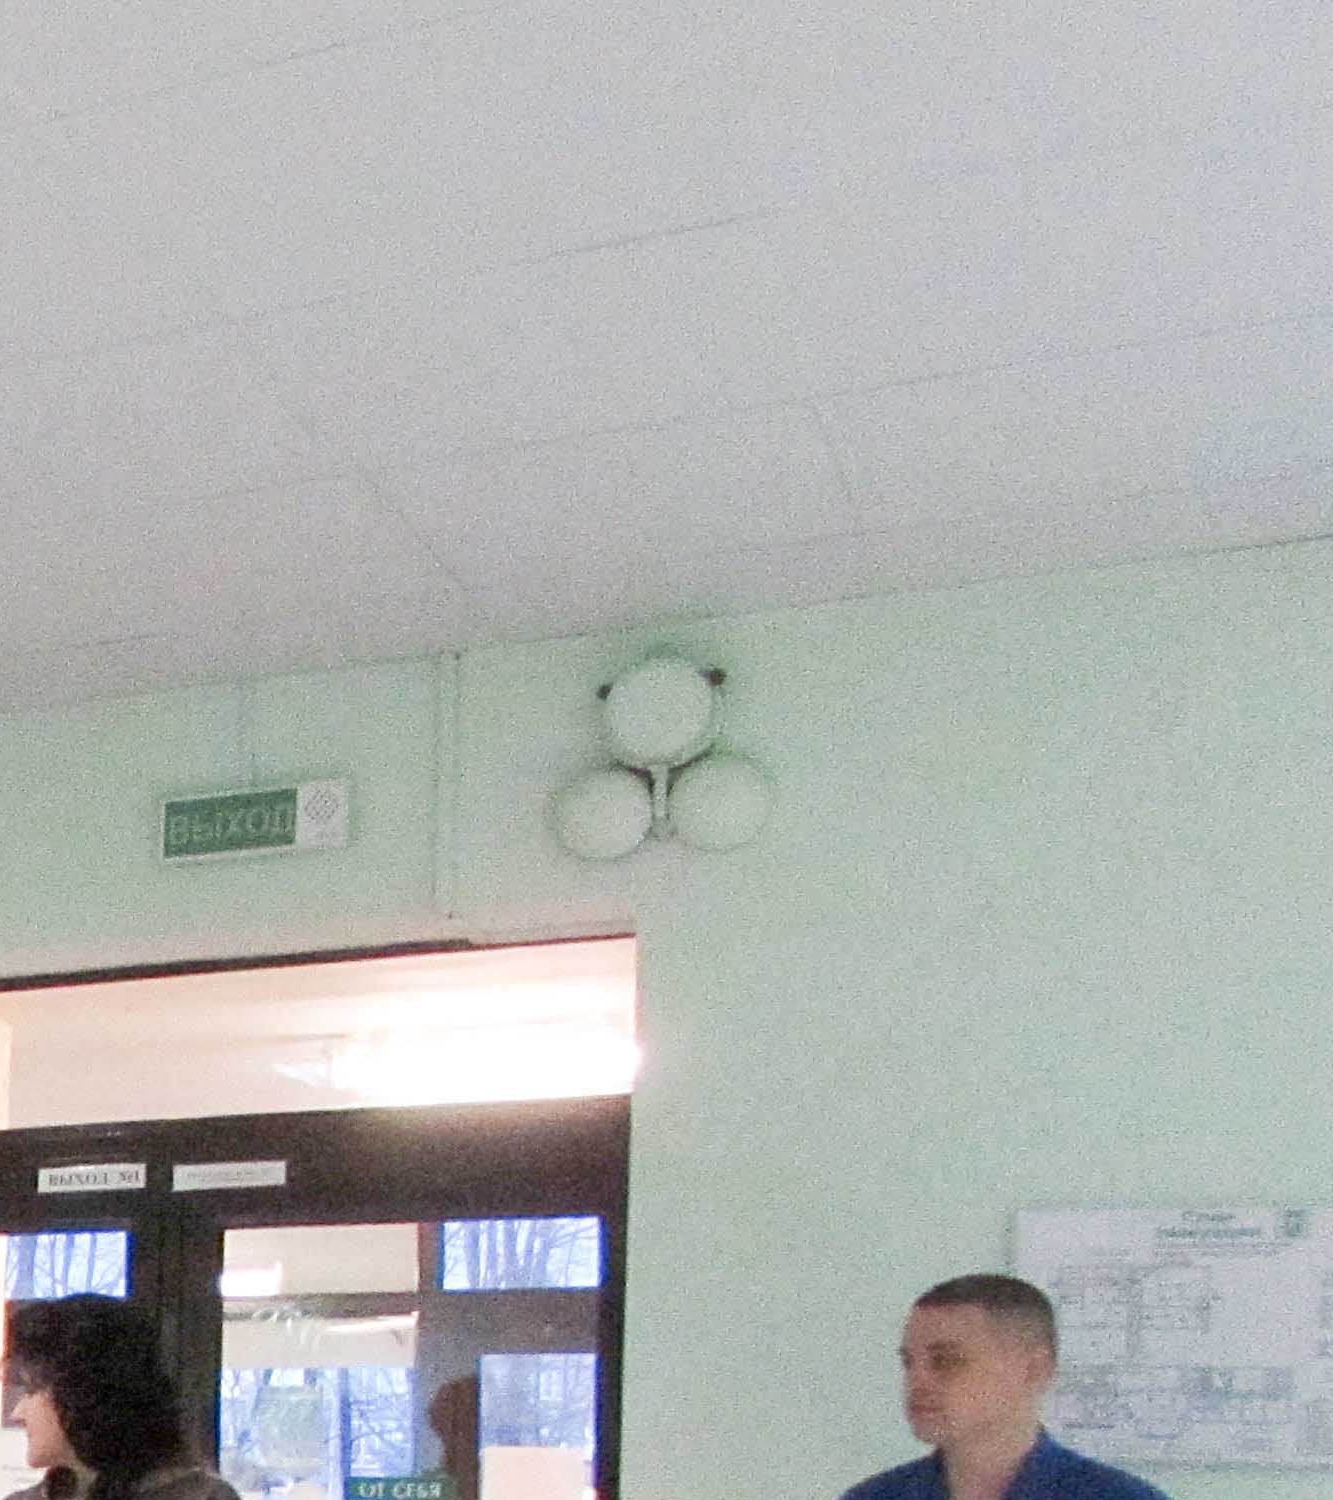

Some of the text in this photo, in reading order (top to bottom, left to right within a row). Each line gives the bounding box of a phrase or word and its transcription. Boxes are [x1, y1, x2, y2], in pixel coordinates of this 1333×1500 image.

[169, 807, 294, 846] ВЫХОД
[48, 1172, 109, 1185] ВЫХОД
[357, 1480, 442, 1499] ОТ СЕБЯ
